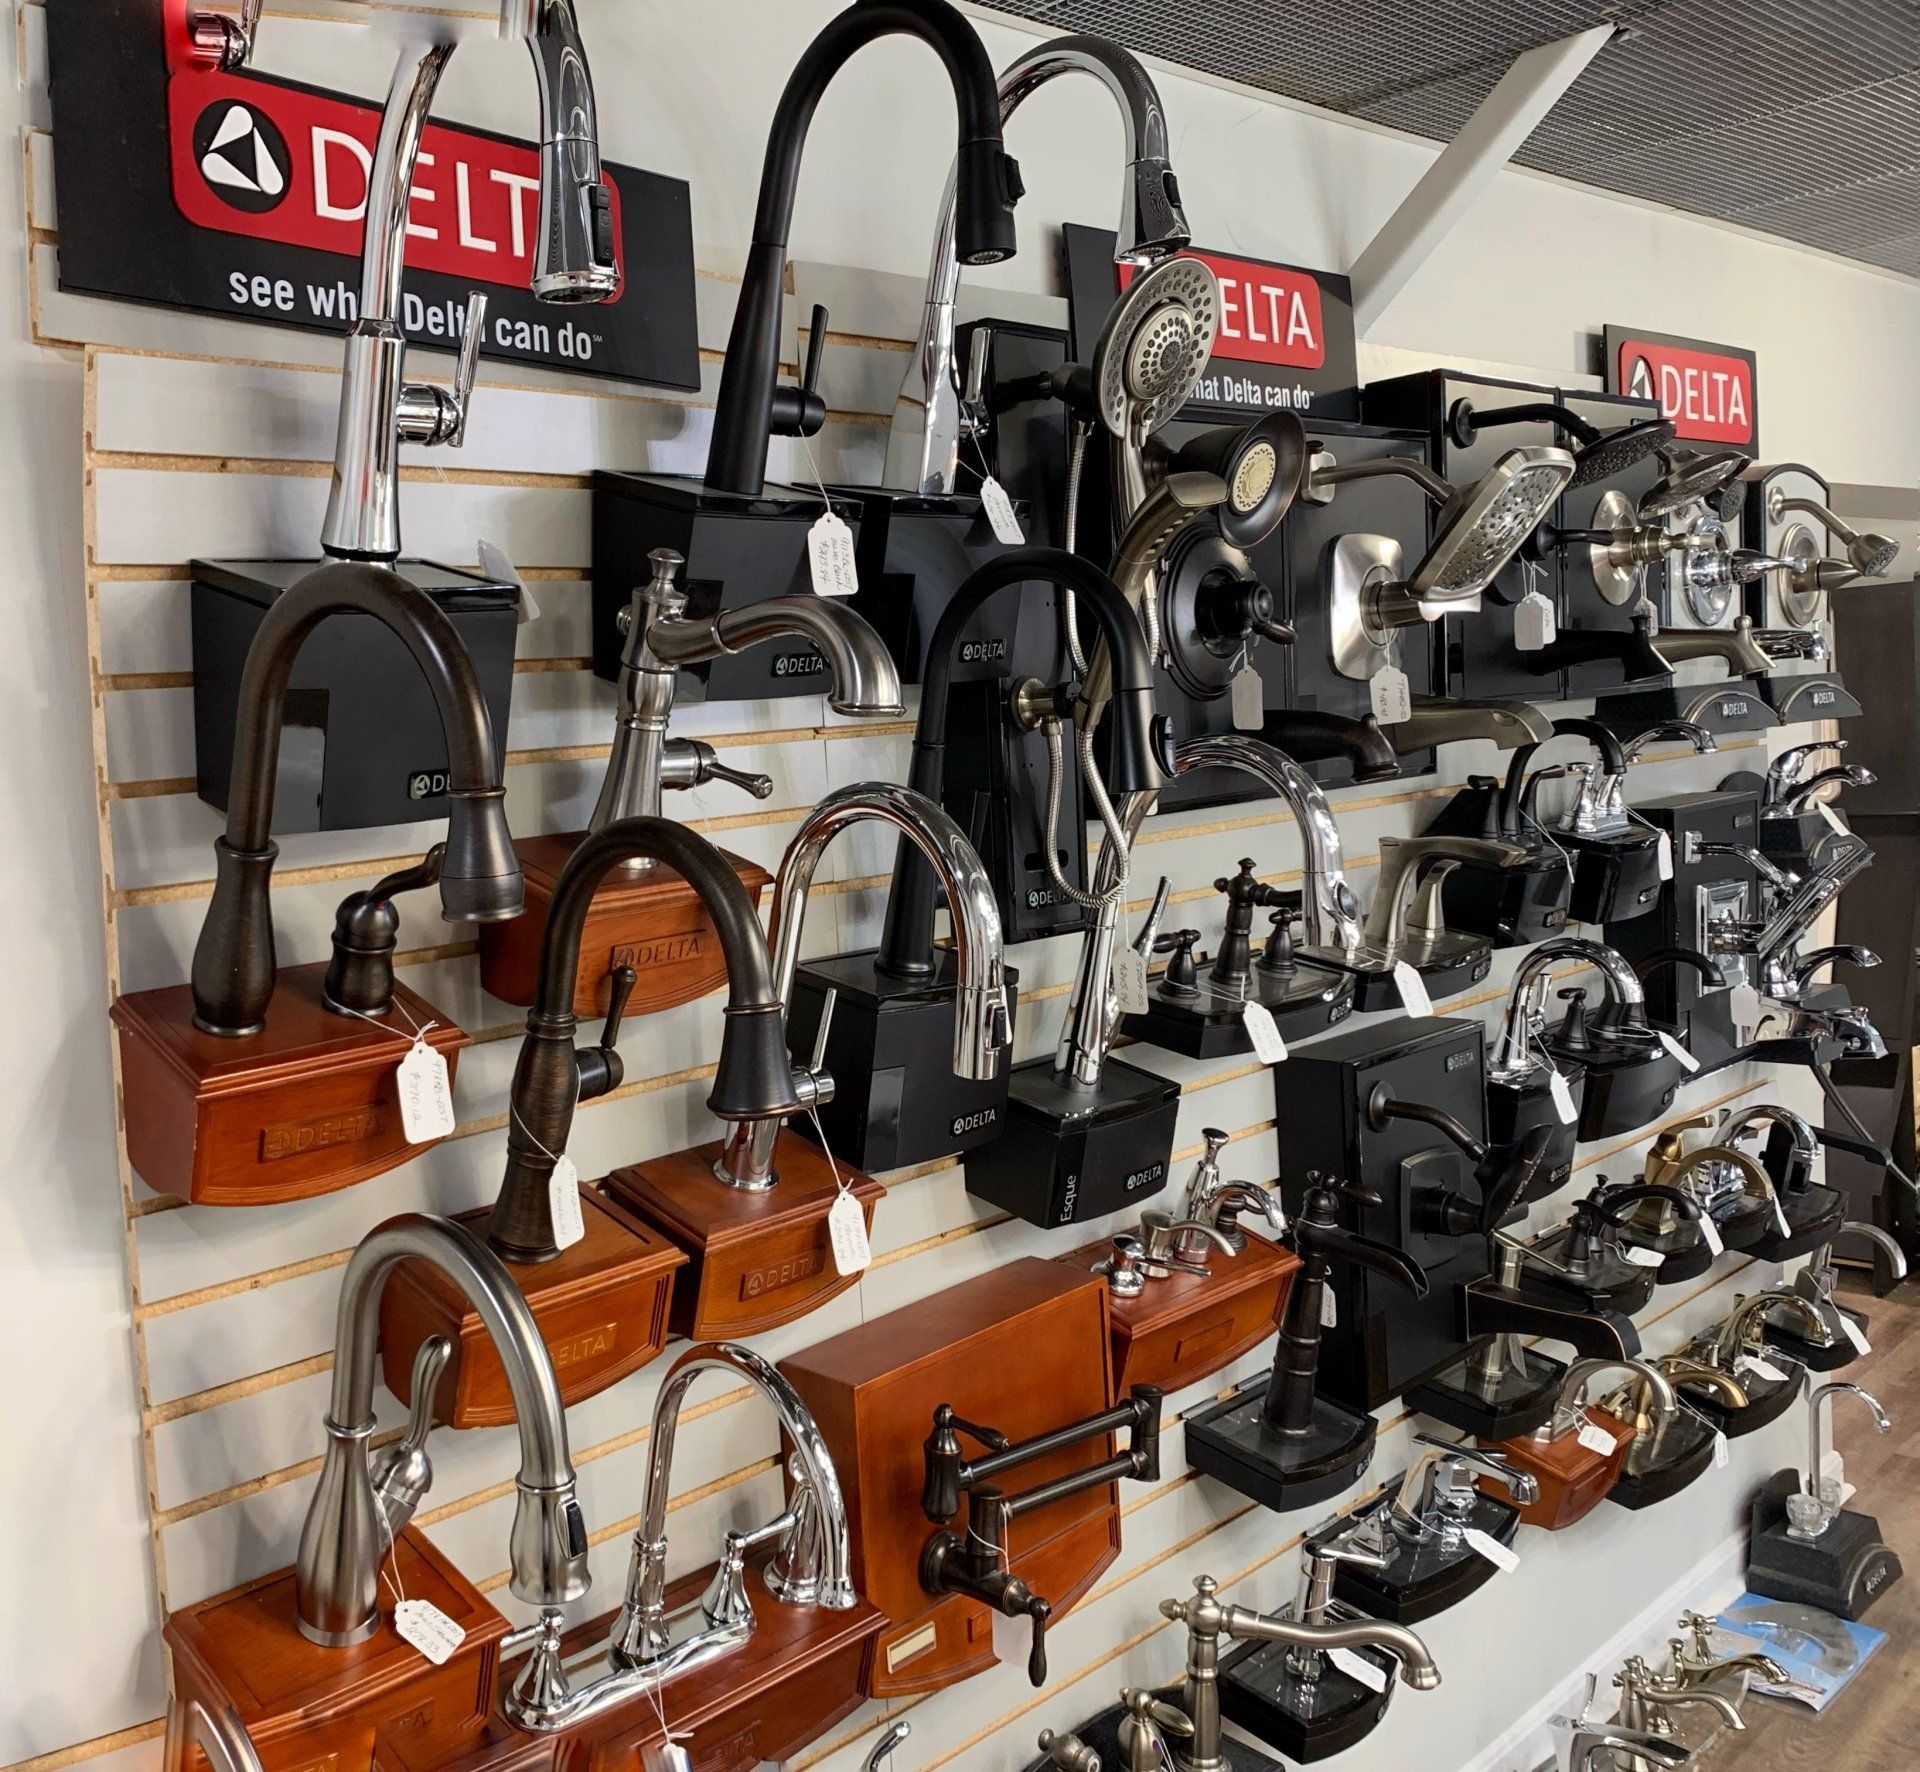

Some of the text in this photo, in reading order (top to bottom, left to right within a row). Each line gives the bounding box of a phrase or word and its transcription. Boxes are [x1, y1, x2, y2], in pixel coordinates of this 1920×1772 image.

[311, 126, 539, 258] DELT
[229, 271, 295, 311] see
[307, 281, 357, 321] wh
[404, 293, 485, 343] Delt
[496, 318, 550, 353] can
[558, 322, 592, 360] do
[1218, 277, 1315, 349] ELTA
[1223, 375, 1262, 405] Delta
[1265, 384, 1291, 408] can
[1294, 383, 1310, 409] do
[1661, 364, 1747, 426] DELTA
[788, 656, 823, 673] DELTA
[973, 643, 1003, 659] DELTA
[1729, 702, 1748, 716] DELTA
[1819, 691, 1836, 704] DELTA
[637, 937, 700, 964] DELTA
[964, 1108, 996, 1131] DELTA
[1136, 1164, 1162, 1186] DELTA
[1060, 1175, 1077, 1222] Esque
[552, 1334, 606, 1366] ELTA
